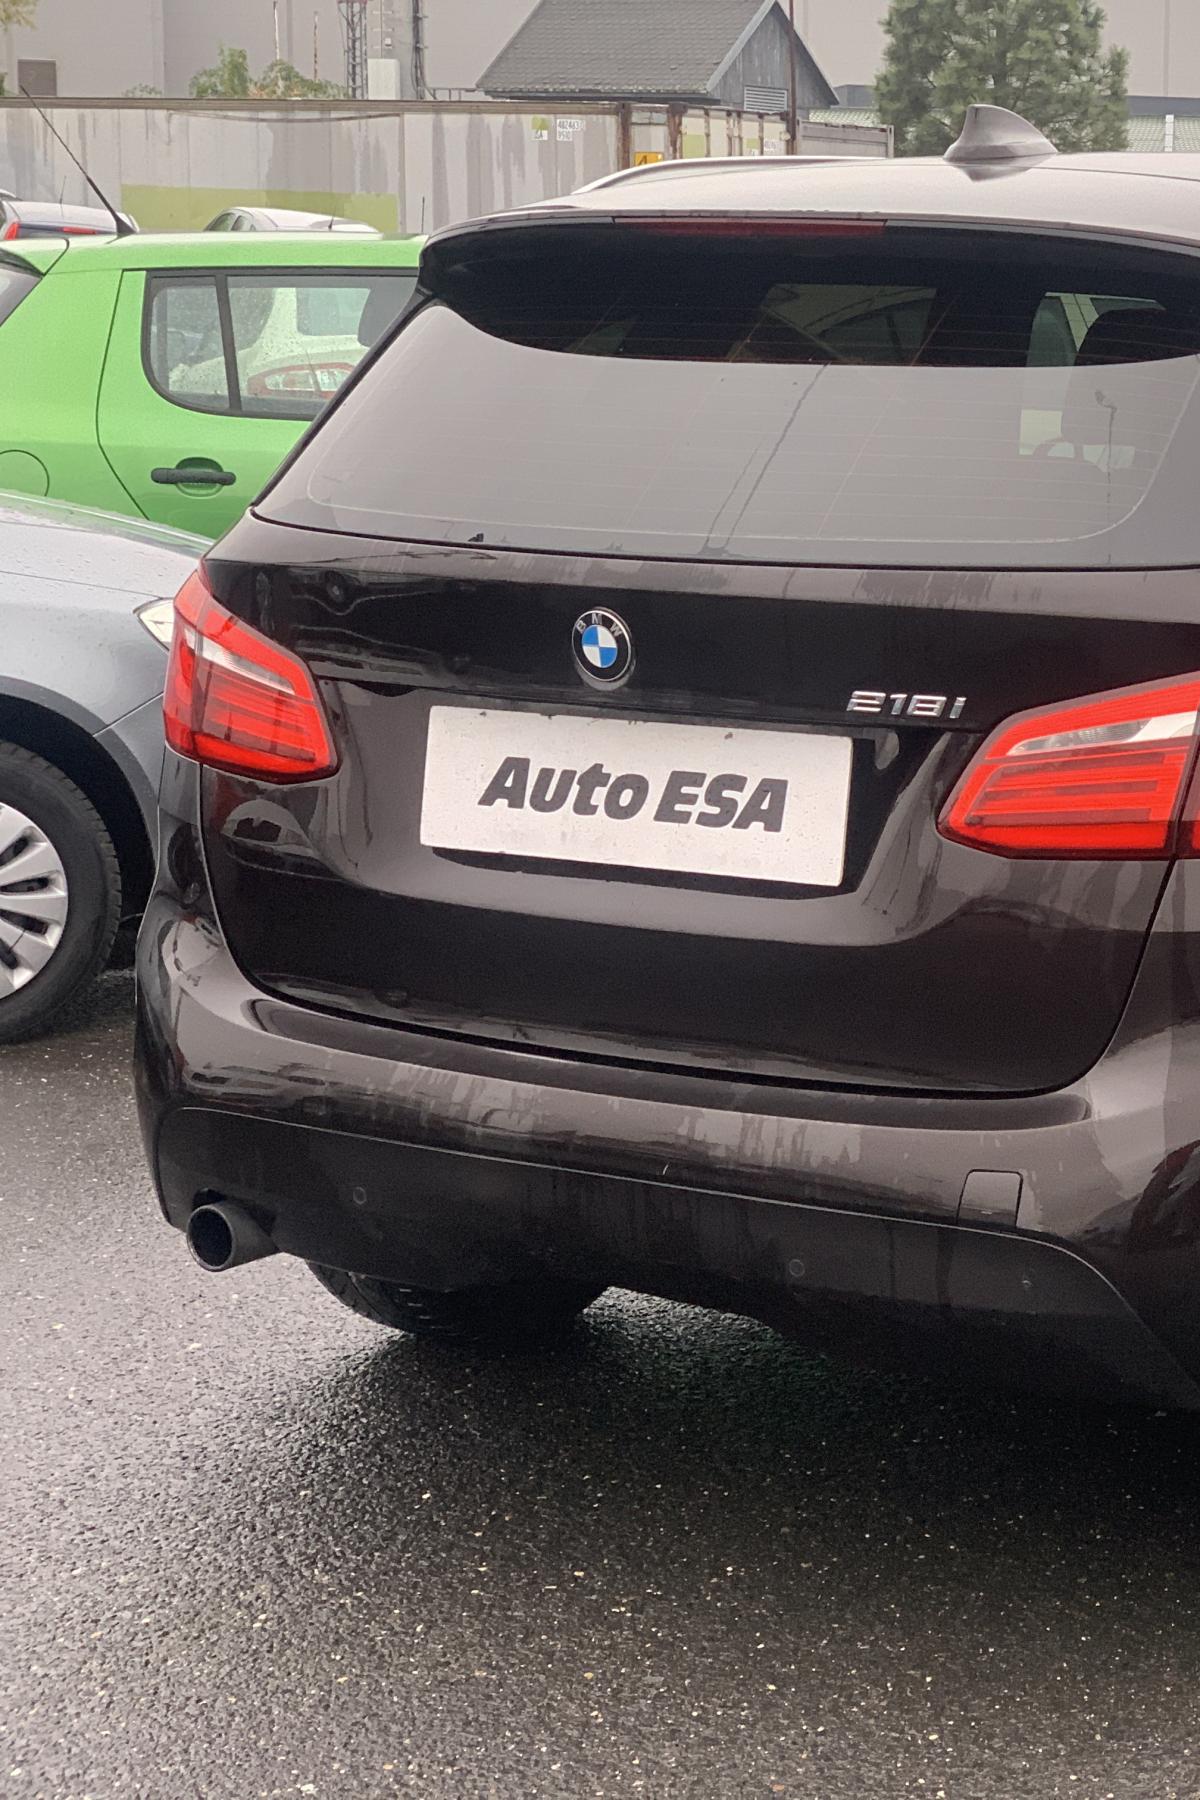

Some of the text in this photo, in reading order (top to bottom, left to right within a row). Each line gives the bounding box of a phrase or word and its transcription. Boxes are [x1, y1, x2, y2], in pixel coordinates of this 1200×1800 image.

[576, 612, 623, 637] BMW
[846, 690, 967, 719] 218i
[478, 756, 788, 833] Auto ESA
